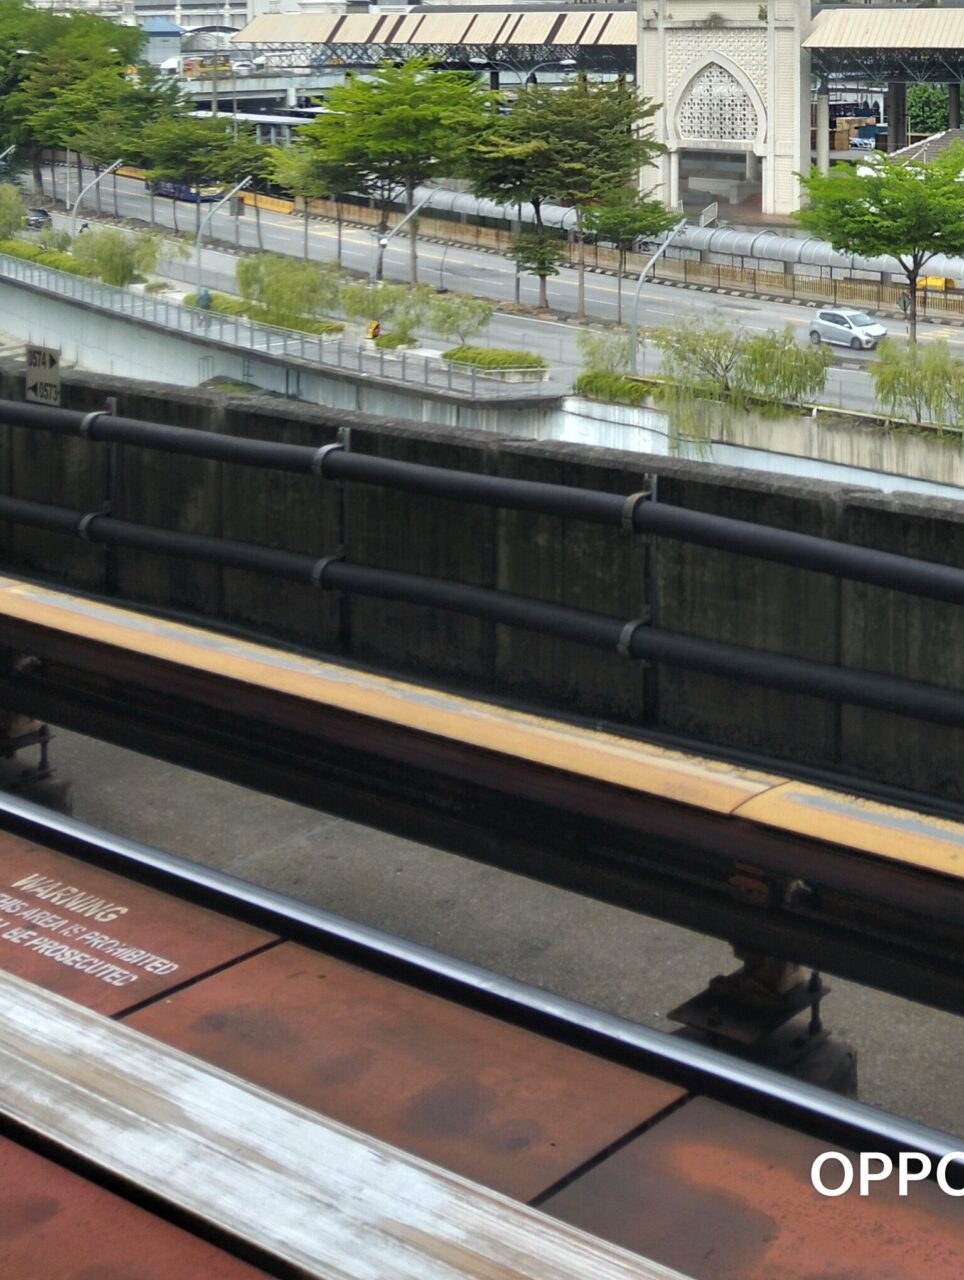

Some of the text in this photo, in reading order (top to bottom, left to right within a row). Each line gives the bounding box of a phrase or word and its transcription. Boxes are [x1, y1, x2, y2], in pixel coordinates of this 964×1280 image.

[11, 873, 129, 922] WARNING
[1, 927, 139, 986] BE PROSECUTED
[15, 908, 69, 931] AREA
[58, 924, 87, 937] IS
[75, 931, 179, 975] PROHIBITED
